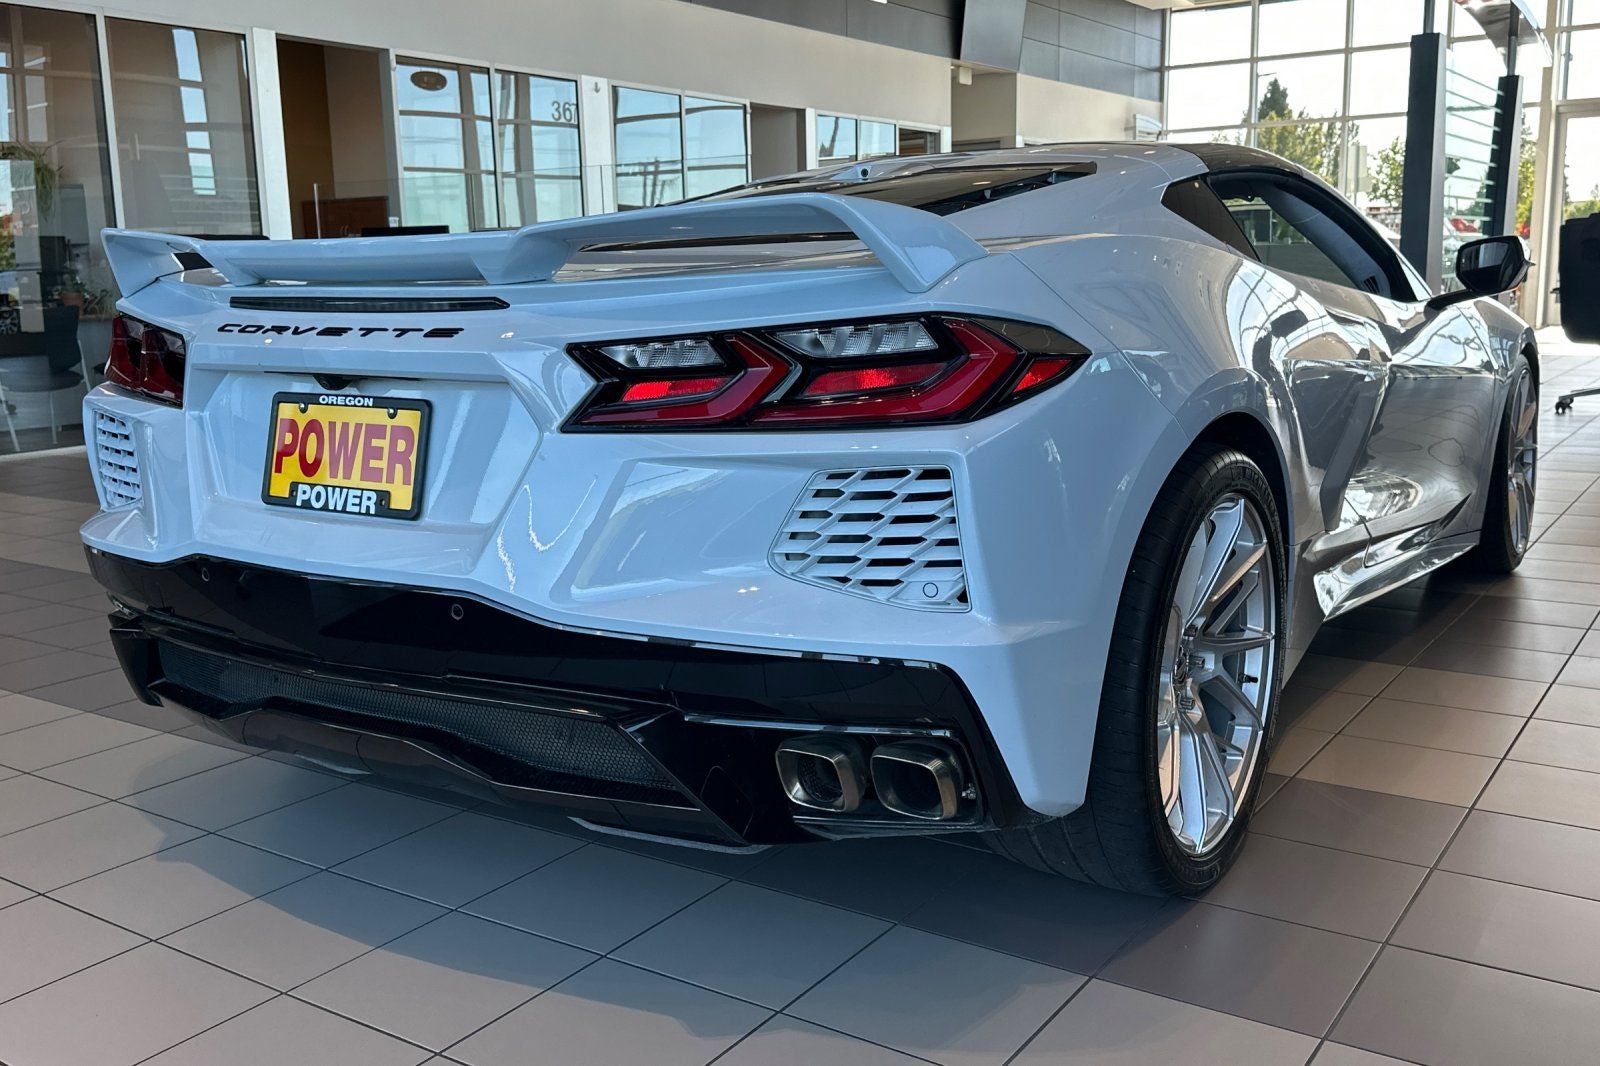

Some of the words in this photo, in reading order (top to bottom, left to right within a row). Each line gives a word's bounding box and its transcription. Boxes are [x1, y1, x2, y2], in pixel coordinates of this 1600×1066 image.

[217, 323, 464, 338] CORVETTE
[319, 395, 373, 407] OREGON
[274, 418, 415, 485] POWER
[296, 484, 377, 514] POWER
